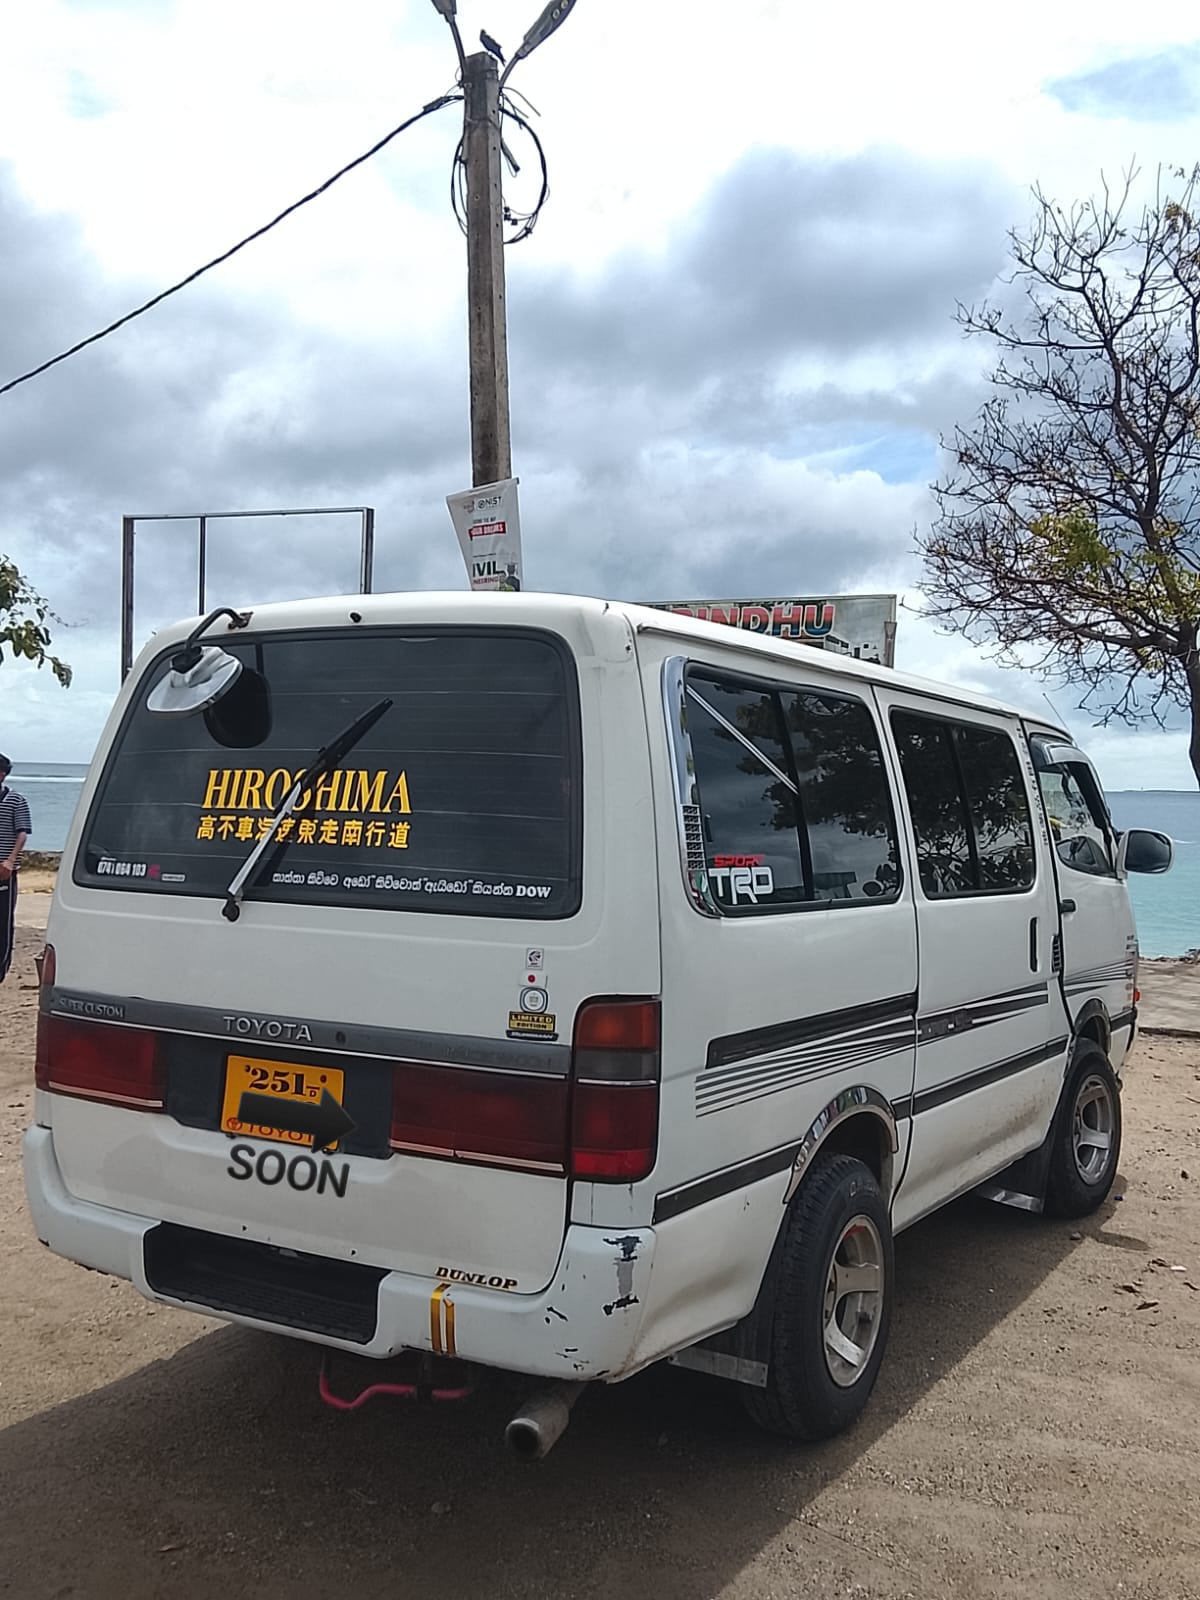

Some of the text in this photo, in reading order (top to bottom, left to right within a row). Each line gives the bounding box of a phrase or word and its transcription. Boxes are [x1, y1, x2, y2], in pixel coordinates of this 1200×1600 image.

[472, 560, 504, 578] IVIL
[201, 768, 412, 814] HIROSHIMA
[708, 866, 774, 905] TRD
[84, 1002, 124, 1018] CUSTOM
[511, 1013, 553, 1024] LIMITED
[222, 1016, 312, 1042] TOYOTA
[435, 1267, 518, 1289] DUNLOP
